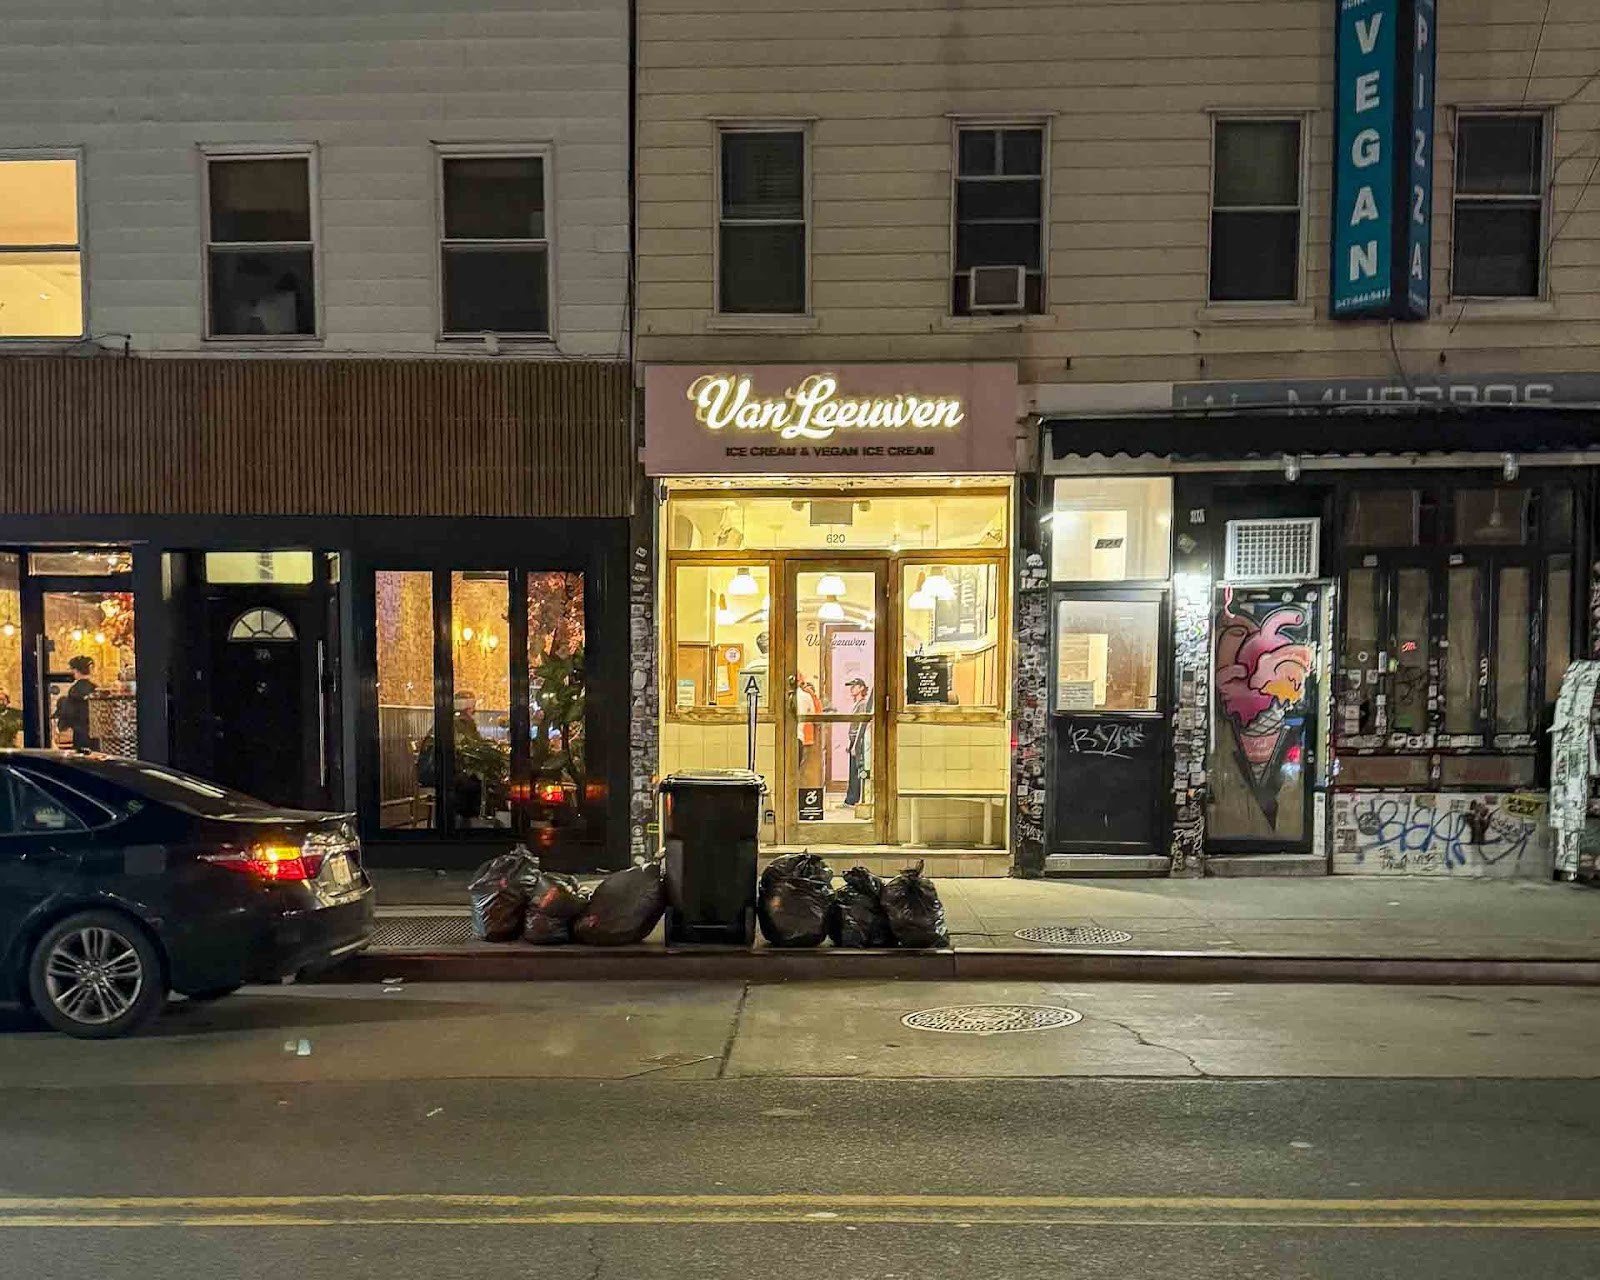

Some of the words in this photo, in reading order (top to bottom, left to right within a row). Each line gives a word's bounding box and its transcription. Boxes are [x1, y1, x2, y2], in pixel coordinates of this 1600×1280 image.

[1349, 12, 1383, 282] VEGAN
[1411, 12, 1429, 281] PIZZA
[693, 376, 791, 430] Van
[781, 378, 965, 440] Leeuwen
[726, 446, 748, 457] ICE
[750, 446, 797, 457] CREAM
[800, 446, 809, 457] &
[813, 446, 859, 457] VEGAN
[862, 446, 884, 457] ICE
[887, 446, 935, 457] CREAM
[826, 533, 846, 544] 620
